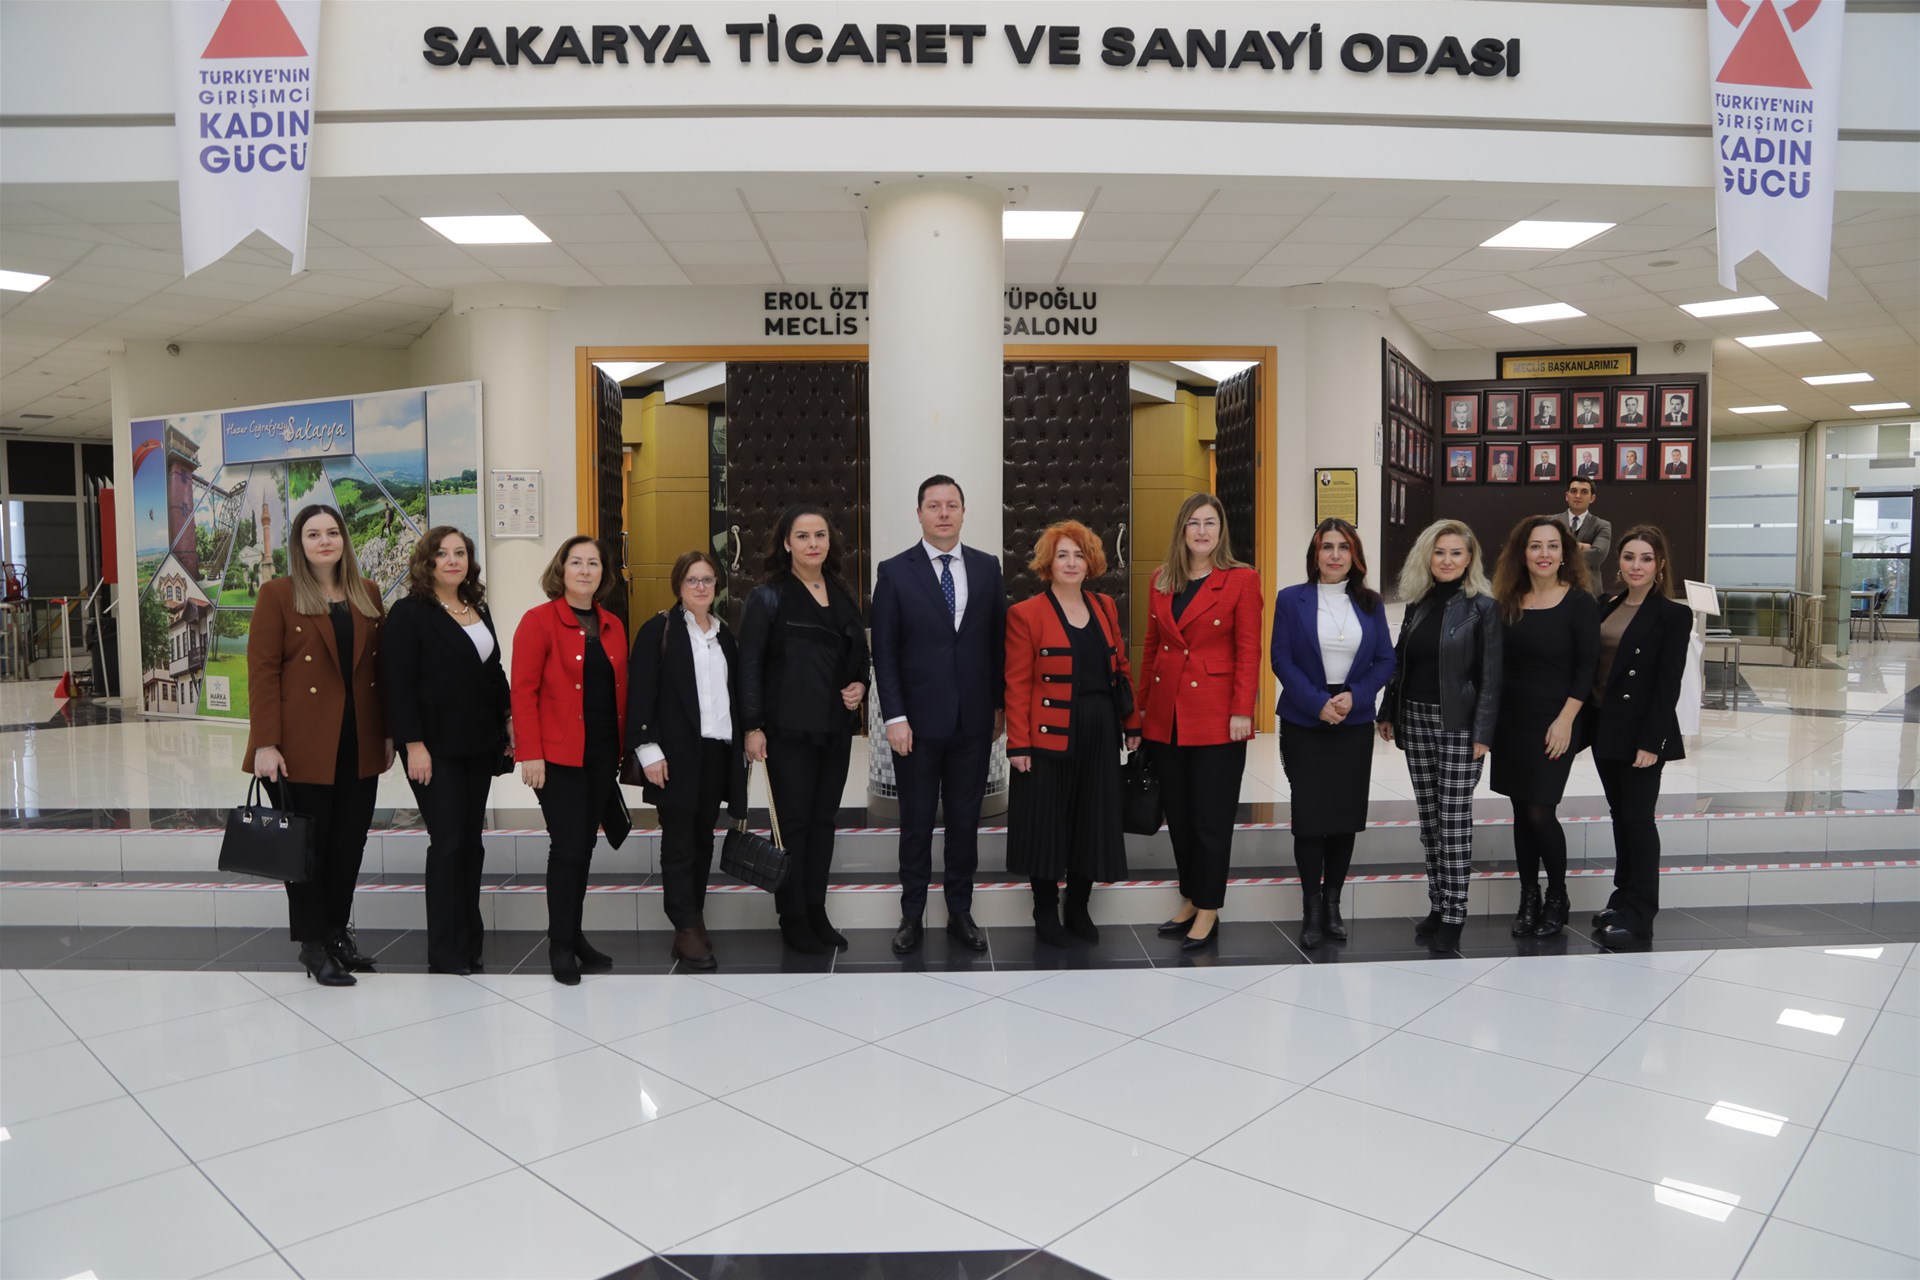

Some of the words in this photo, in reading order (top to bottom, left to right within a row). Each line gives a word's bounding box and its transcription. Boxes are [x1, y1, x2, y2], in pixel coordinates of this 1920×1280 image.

[423, 23, 710, 67] SAKARYA
[726, 14, 987, 64] TİCARET
[1004, 25, 1081, 66] VE
[1101, 23, 1322, 72] SANAYİ
[1340, 33, 1520, 77] ODASI
[199, 67, 310, 85] TÜRKİYE'NİN
[199, 87, 310, 108] GİRİŞİMCİ
[200, 109, 309, 139] KADIN
[199, 142, 307, 174] GÜCÜ
[764, 291, 823, 310] EROL
[1004, 286, 1097, 310] ÜPOĞLU
[764, 313, 858, 336] MECLİS
[1513, 360, 1546, 374] MECLİS
[1548, 360, 1619, 374] BAŞKANLARIMIZ
[285, 416, 347, 451] Sakarya
